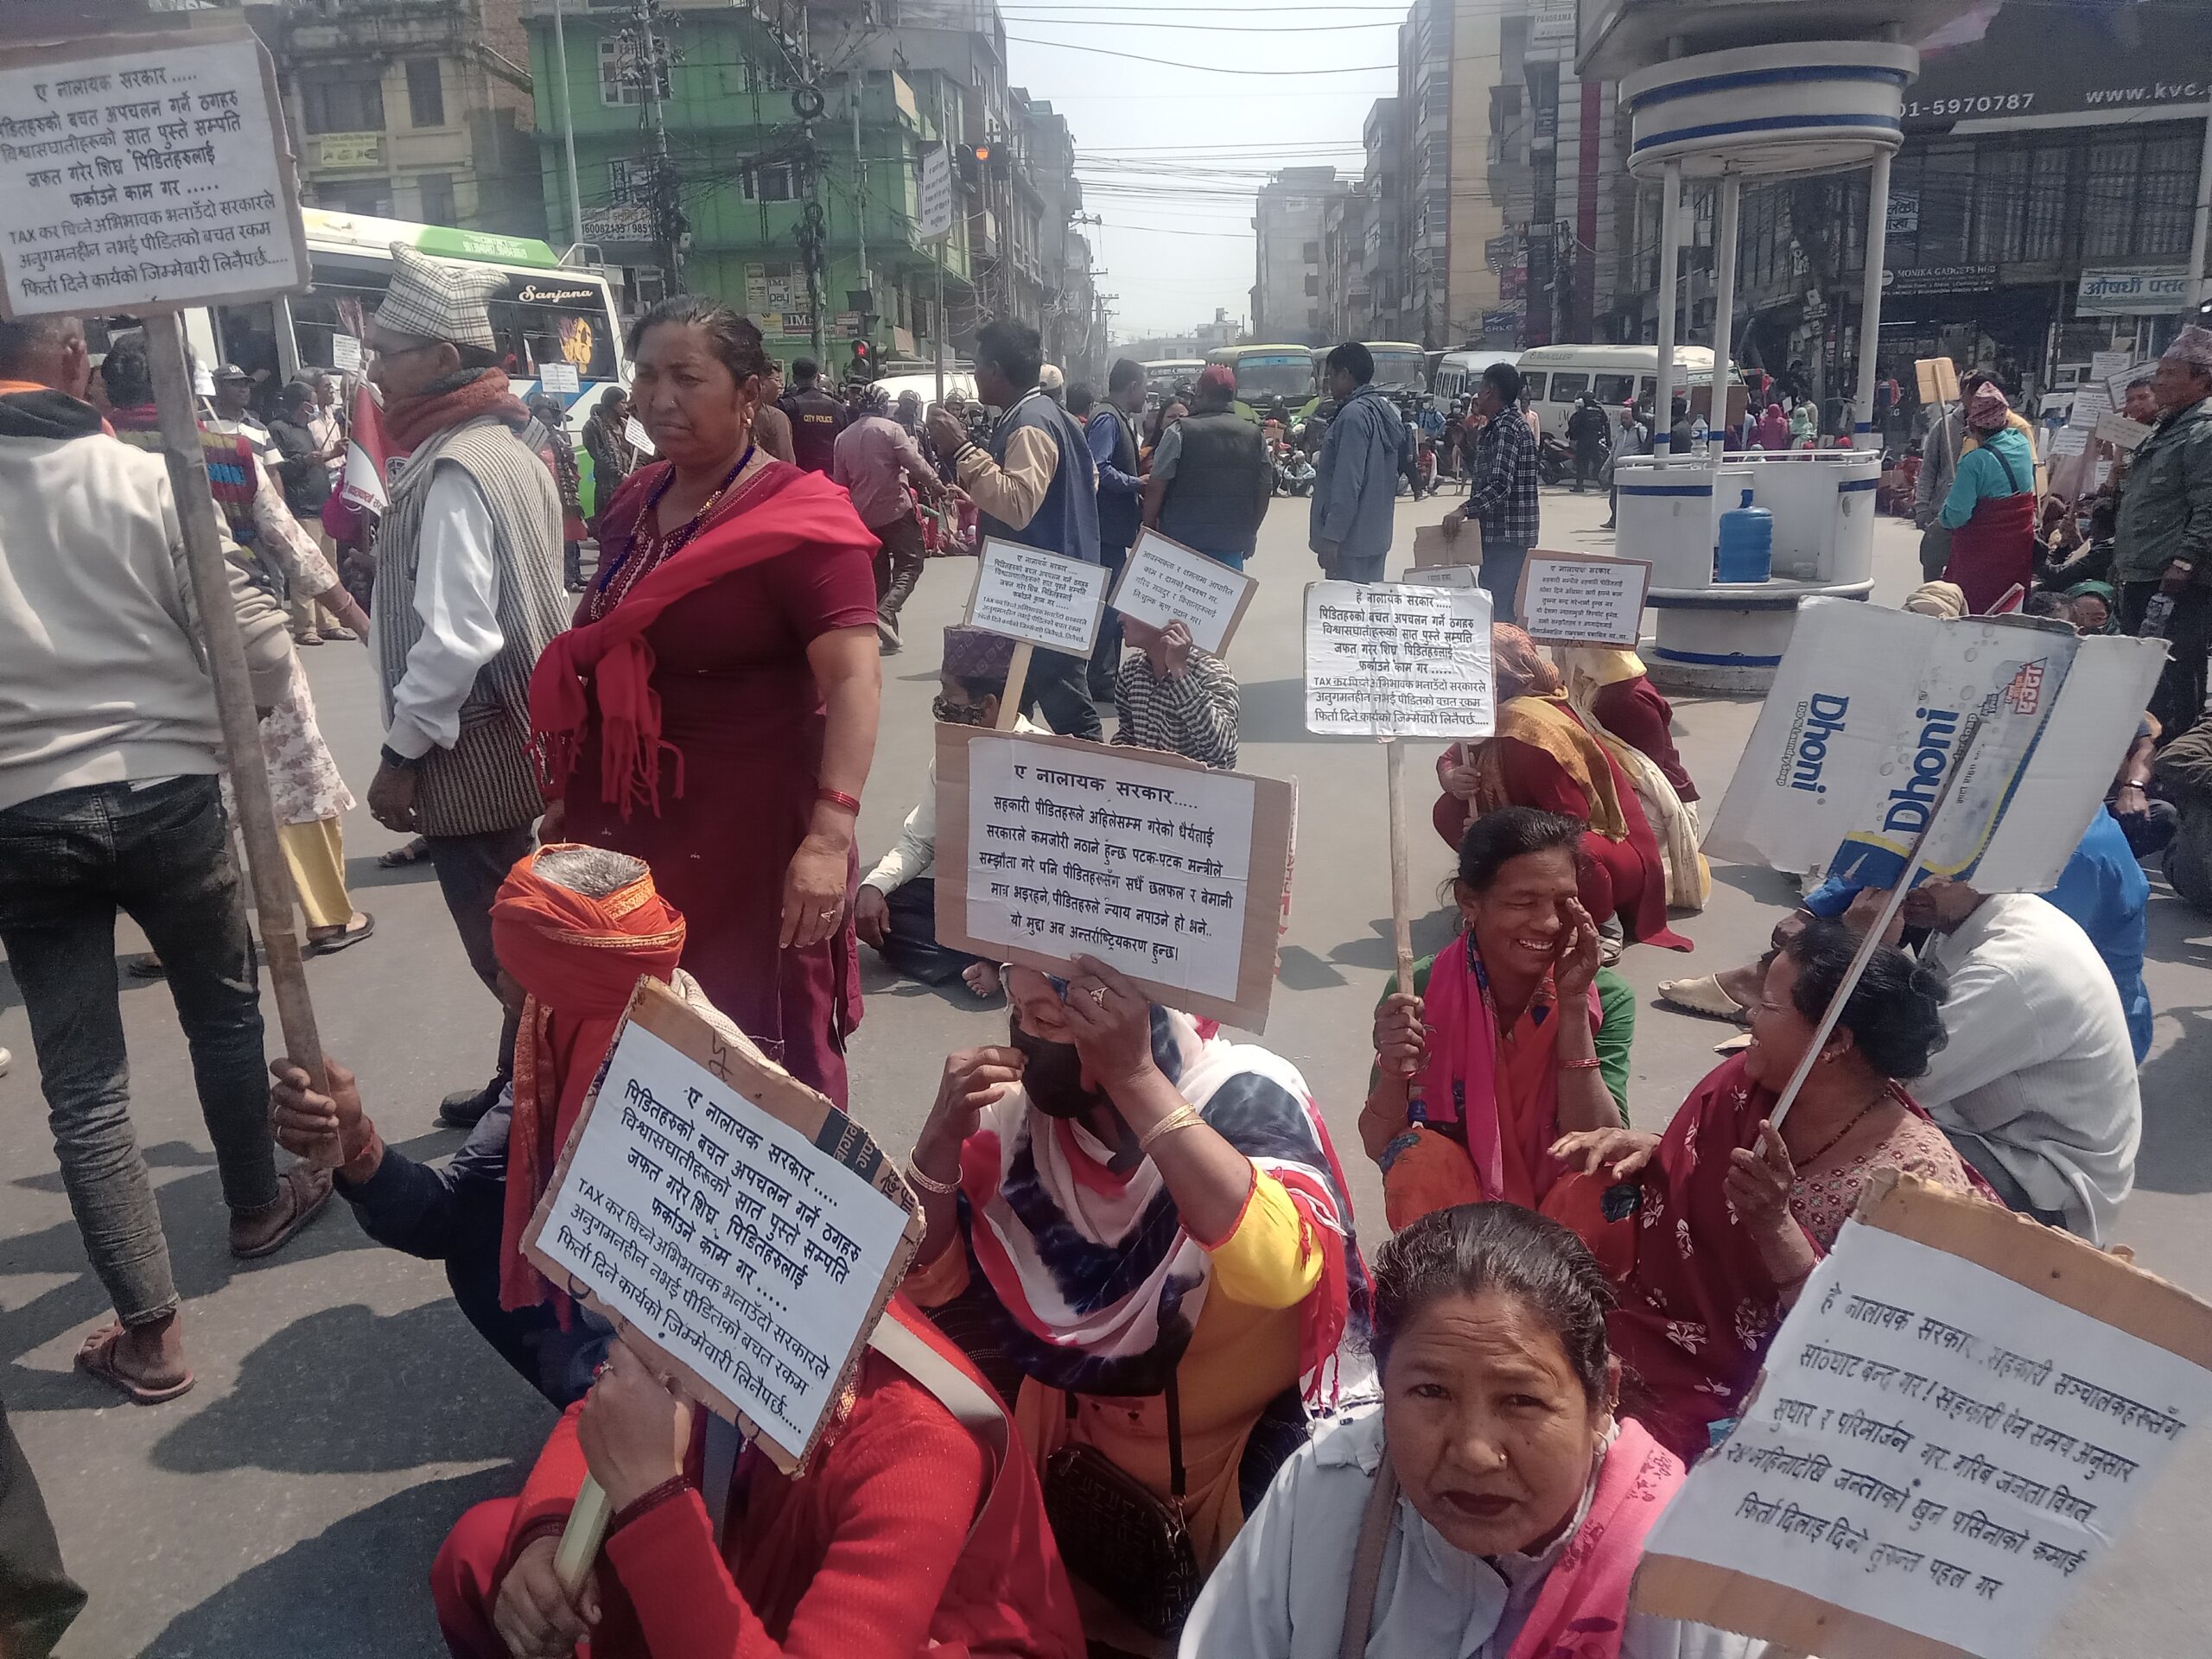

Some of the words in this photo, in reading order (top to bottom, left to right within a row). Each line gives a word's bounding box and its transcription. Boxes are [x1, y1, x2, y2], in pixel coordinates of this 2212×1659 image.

[33, 83, 48, 103] ए
[123, 182, 153, 200] काम
[9, 229, 36, 245] TAX
[38, 225, 60, 239] कर
[238, 221, 270, 239] रकम
[518, 285, 593, 303] Sanjana
[769, 294, 790, 304] pay
[804, 414, 815, 423] CITY
[816, 415, 834, 424] POLICE
[1313, 677, 1332, 686] TAX
[1791, 693, 1850, 794] Dhoni
[1014, 765, 1027, 779] ए
[1036, 768, 1106, 791] नालायक
[1882, 707, 1960, 834] Dhoni
[994, 796, 1030, 813] सहकारी
[1035, 798, 1085, 822] पीडितहरूले
[1089, 808, 1142, 831] अहिलेसम्म
[1147, 817, 1174, 837] गरेको
[987, 824, 1027, 842] सरकारले
[1031, 830, 1069, 849] कमजोरी
[1187, 858, 1224, 879] मन्त्रीले
[979, 851, 1017, 869] सम्झौता
[1020, 855, 1035, 872] गरे
[1039, 858, 1058, 875] पनि
[1149, 881, 1185, 899] छलफल
[1190, 889, 1197, 903] र
[1201, 887, 1233, 909] बेमानी
[1010, 911, 1022, 927] यो
[1049, 921, 1065, 936] अब
[1052, 888, 1101, 914] पीडितहरुले
[1136, 909, 1170, 927] नपाउने
[1175, 913, 1185, 932] हो
[687, 1086, 703, 1109] ए
[706, 1101, 764, 1150] नालायक
[624, 1078, 696, 1141] पिडितहरुको
[698, 1134, 729, 1167] बचत
[731, 1160, 792, 1208] अपचलन
[796, 1200, 822, 1229] गर्ने
[823, 1222, 861, 1262] ठगहरु
[621, 1107, 732, 1198] विश्वासघातीहरूको
[735, 1190, 766, 1221] सात
[766, 1212, 801, 1251] पुस्ते
[804, 1238, 850, 1285] सम्पति
[628, 1147, 664, 1182] जफत
[666, 1174, 690, 1206] गरेर
[726, 1214, 808, 1290] पिडितहरुलाई
[652, 1197, 696, 1243] फर्काउने
[700, 1236, 732, 1267] काम
[557, 1225, 592, 1263] फिर्ता
[591, 1251, 620, 1284] दिने
[619, 1275, 664, 1321] कार्यको
[663, 1308, 734, 1373] जिम्मेवारी
[570, 1204, 649, 1268] अनुगमनहीन
[650, 1262, 682, 1300] नभई
[741, 1332, 775, 1367] बचत
[775, 1359, 810, 1396] रकम
[579, 1178, 604, 1206] TAX
[606, 1198, 626, 1223] कर
[653, 1236, 723, 1293] अभिभावक
[722, 1285, 773, 1332] भनाउँदो
[773, 1324, 830, 1380] सरकारले
